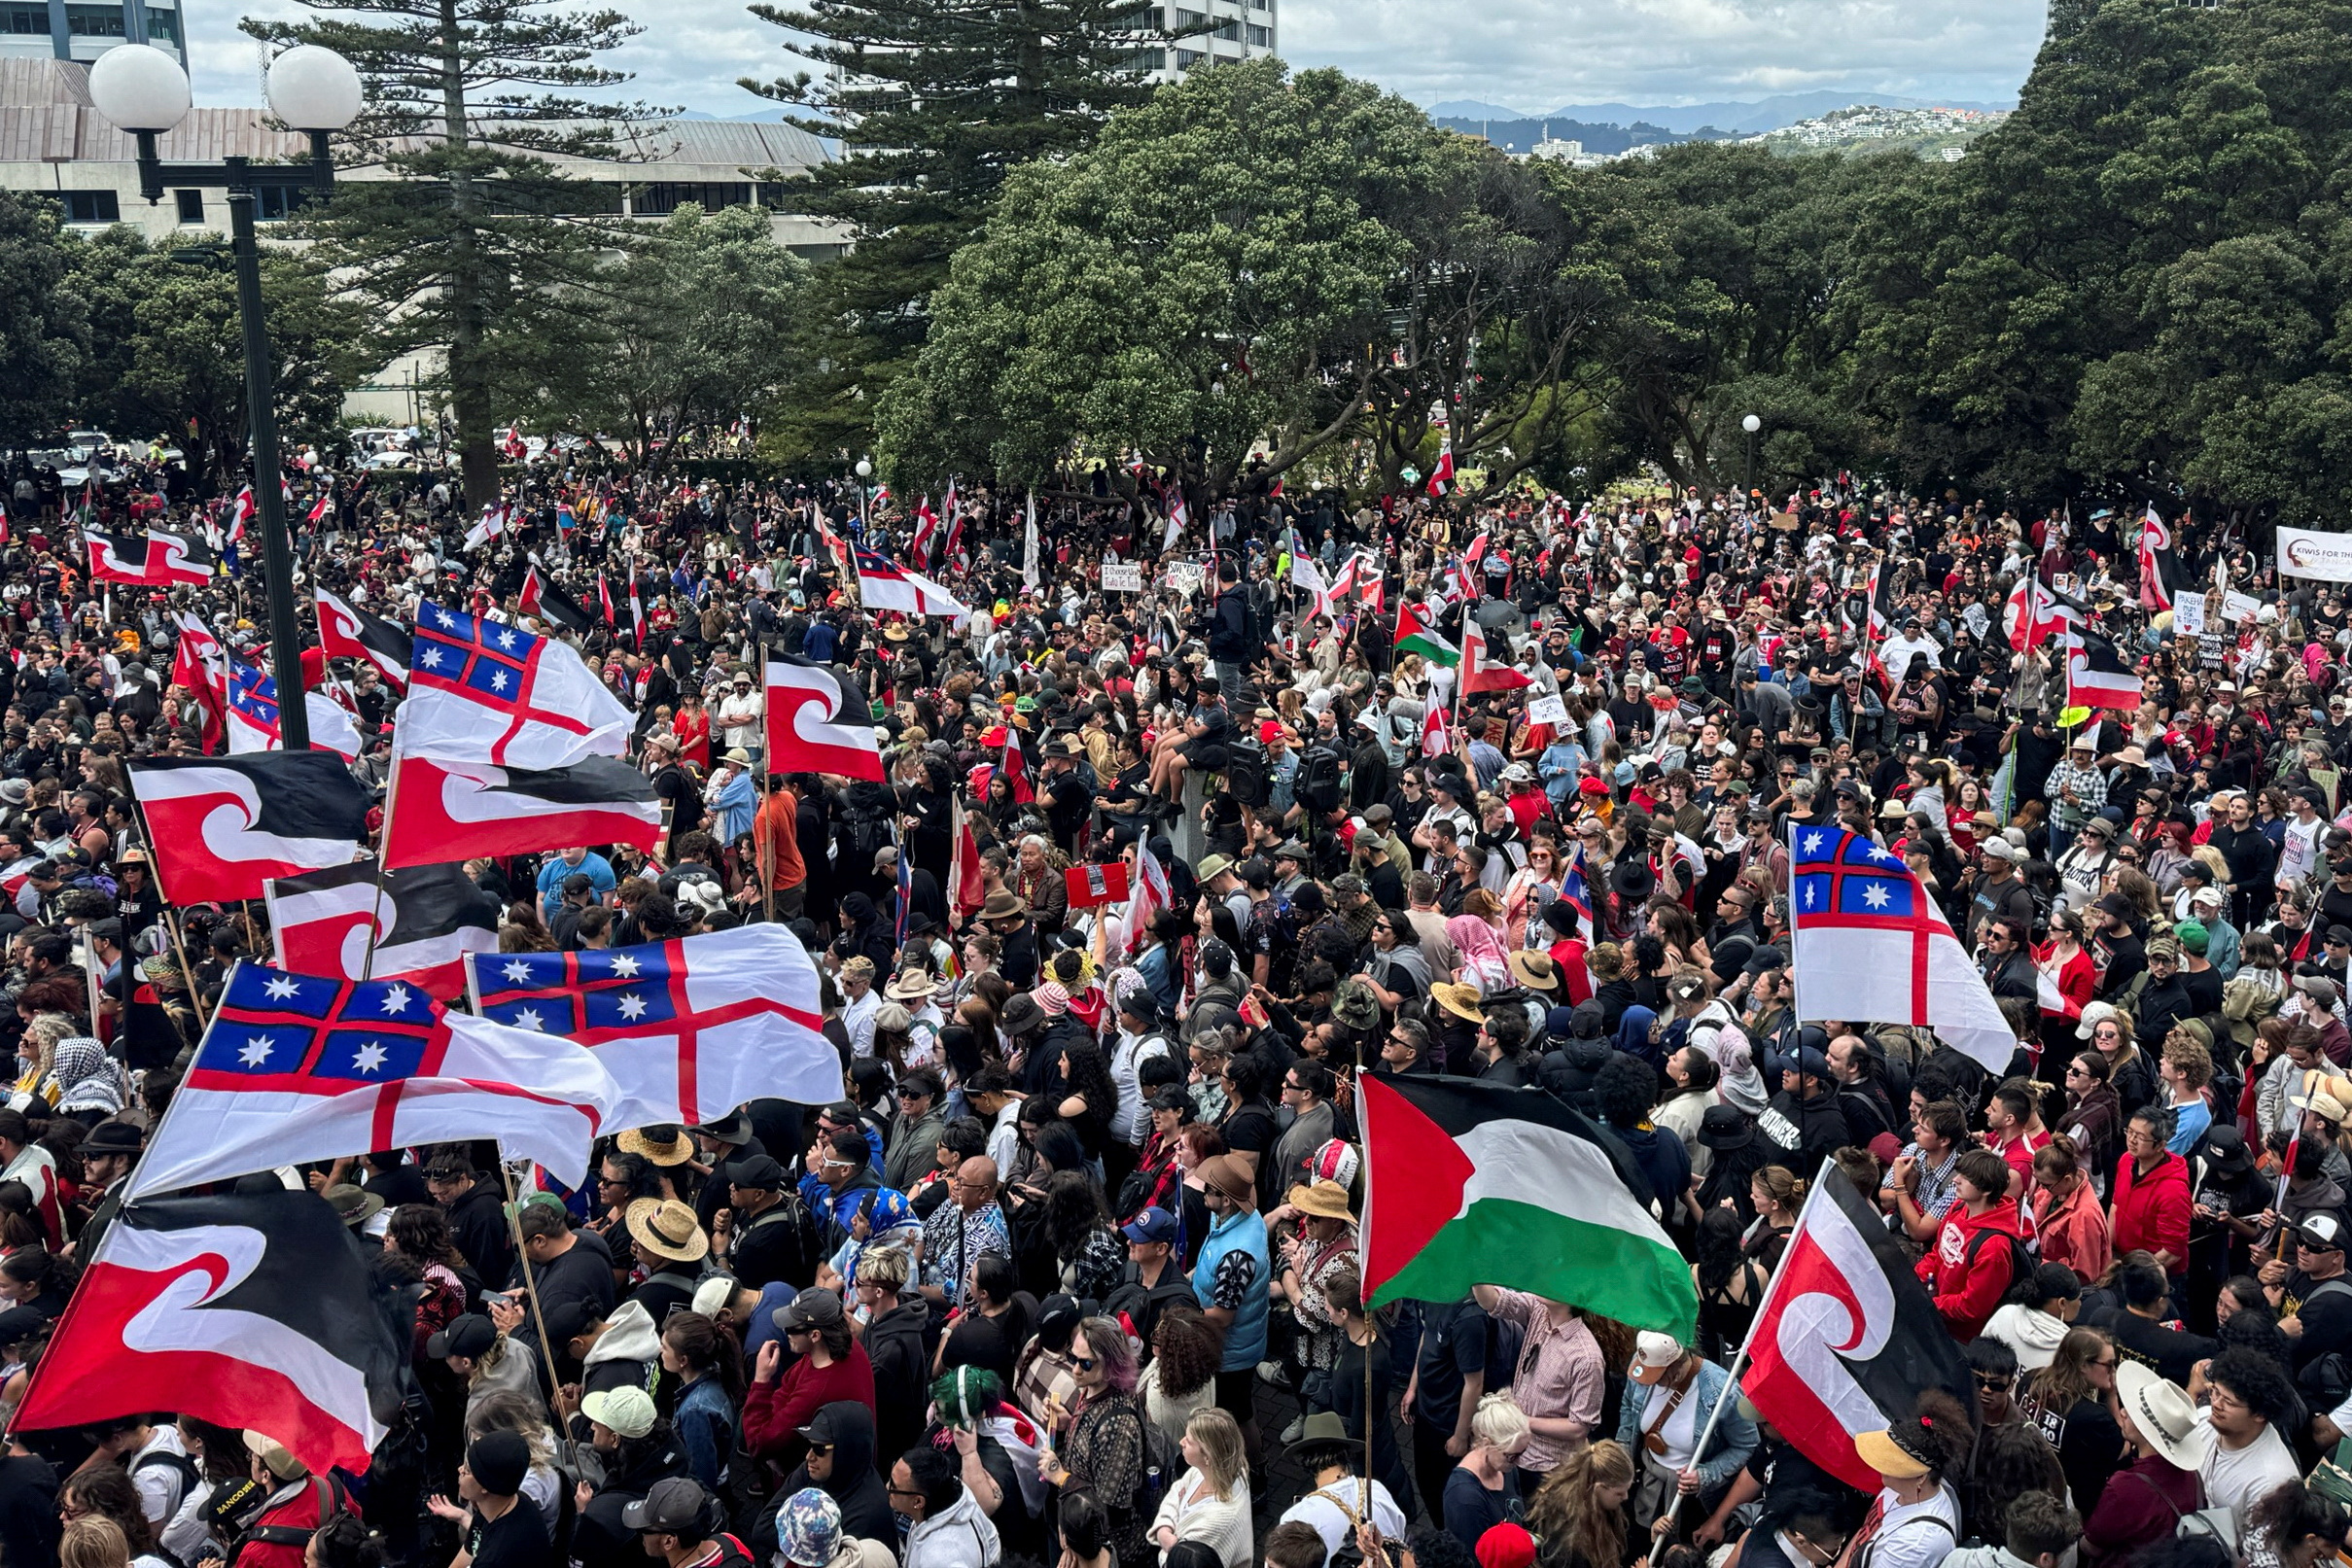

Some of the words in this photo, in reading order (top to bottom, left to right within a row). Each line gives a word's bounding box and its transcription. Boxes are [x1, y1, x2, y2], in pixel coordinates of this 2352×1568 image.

[2297, 546, 2320, 556] KIWIS
[2322, 549, 2339, 558] FOR
[2044, 1413, 2057, 1430] 18
